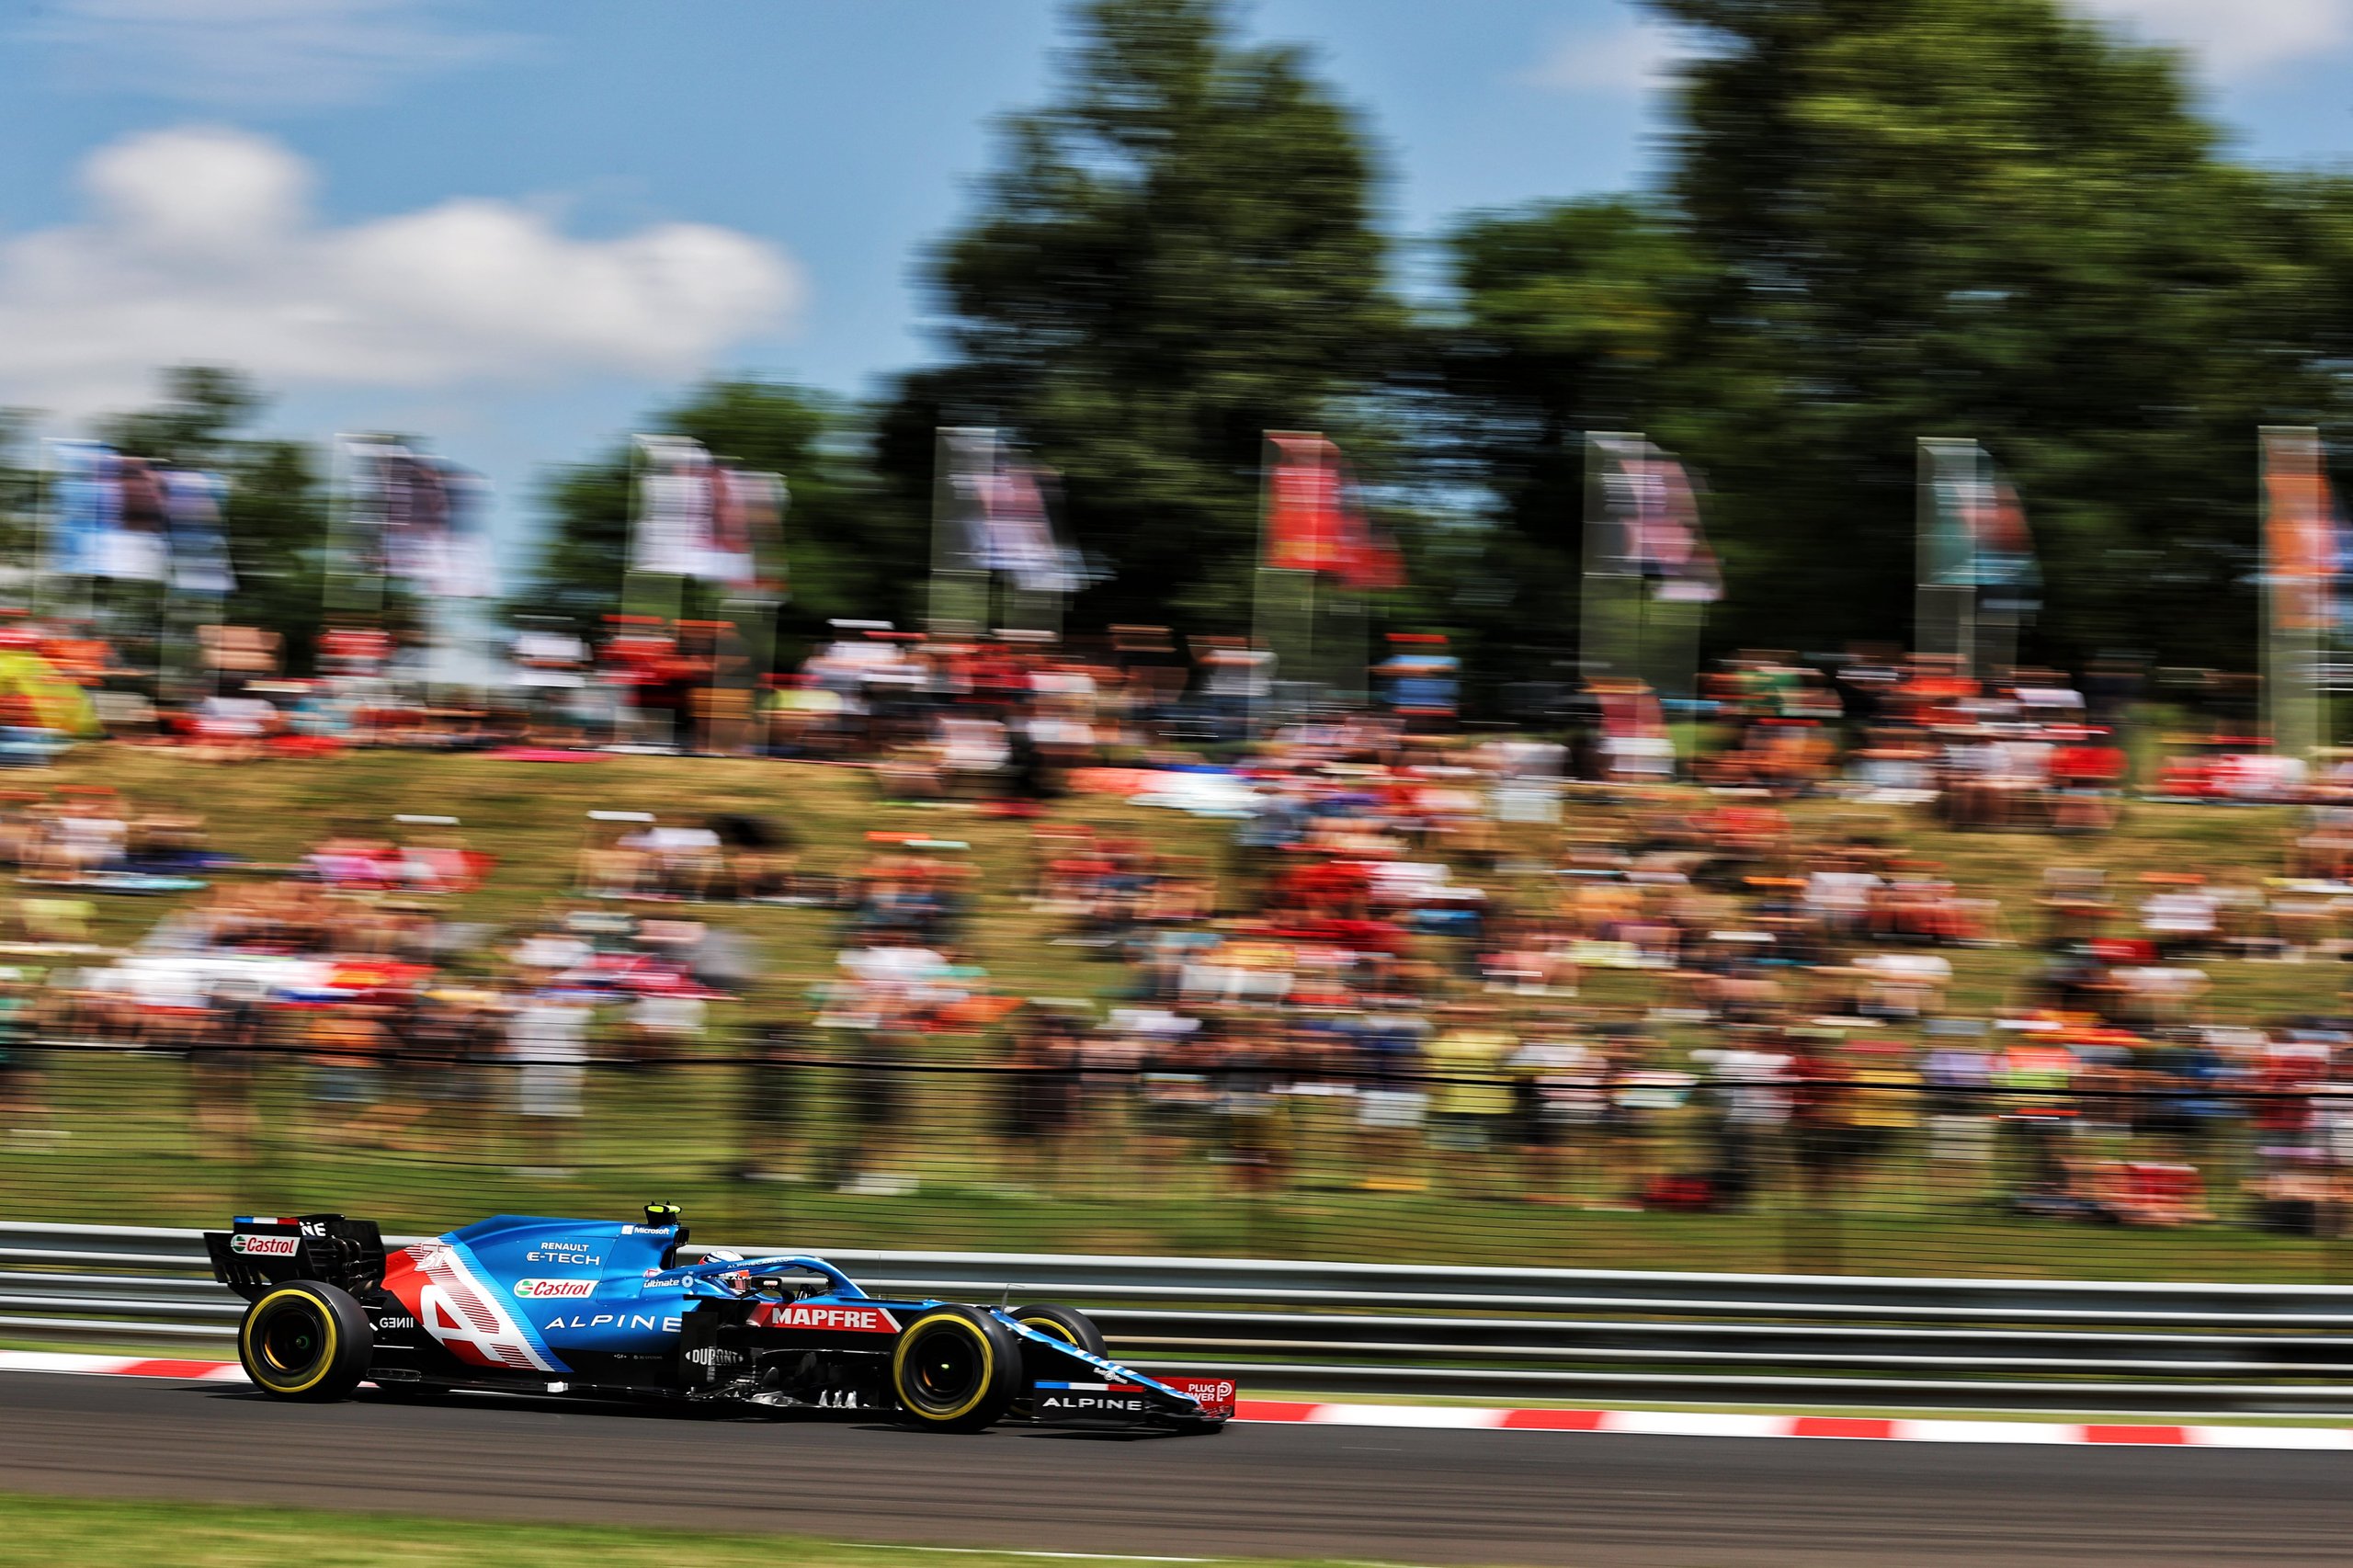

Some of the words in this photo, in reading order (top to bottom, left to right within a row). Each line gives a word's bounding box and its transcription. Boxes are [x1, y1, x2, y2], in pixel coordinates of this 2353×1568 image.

[634, 1226, 669, 1234] Microsoft
[246, 1237, 294, 1254] Castrol
[540, 1242, 589, 1252] RENAULT
[527, 1252, 600, 1266] E-TECH
[533, 1281, 590, 1296] Castrol
[643, 1278, 680, 1288] ultimate
[544, 1314, 682, 1333] ALPINE
[772, 1307, 877, 1329] MAPFRE
[1188, 1383, 1215, 1393] PLUG
[1042, 1397, 1142, 1411] ALPINE
